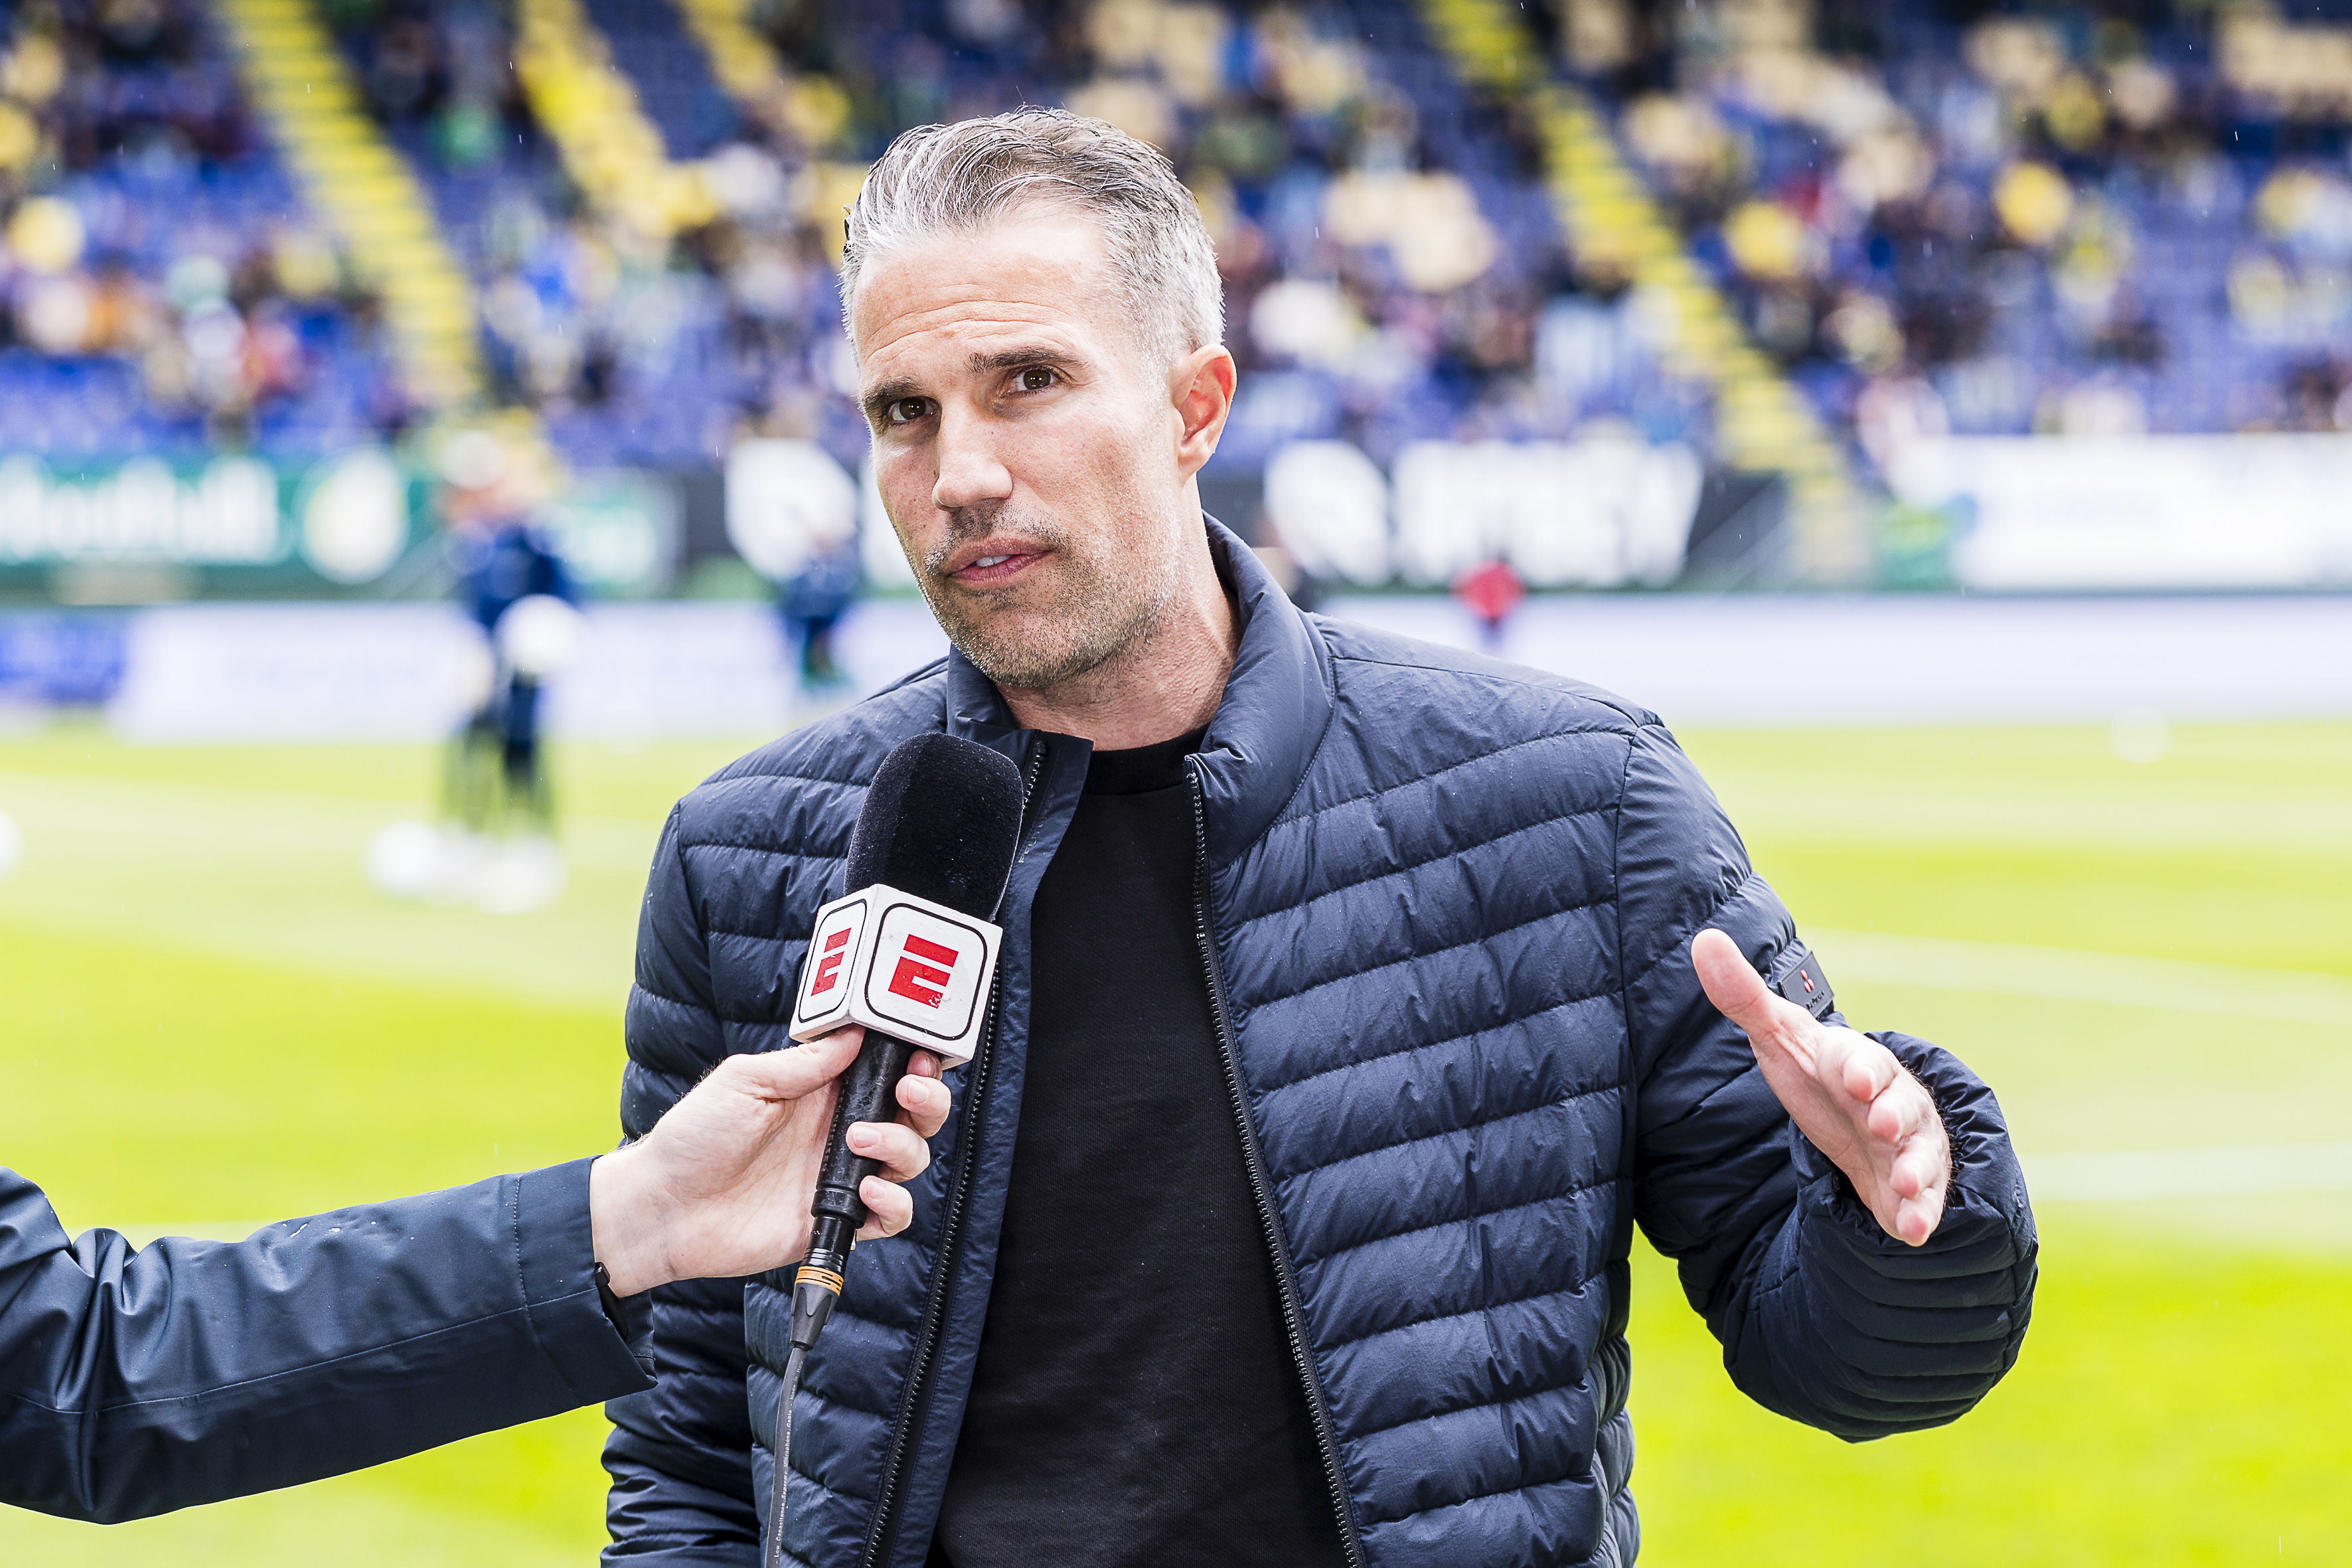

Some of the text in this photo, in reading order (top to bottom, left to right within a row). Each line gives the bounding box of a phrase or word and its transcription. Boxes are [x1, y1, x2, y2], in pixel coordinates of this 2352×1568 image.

[811, 927, 852, 996] E
[888, 933, 959, 1009] E
[821, 1089, 845, 1172] SENNHEISER
